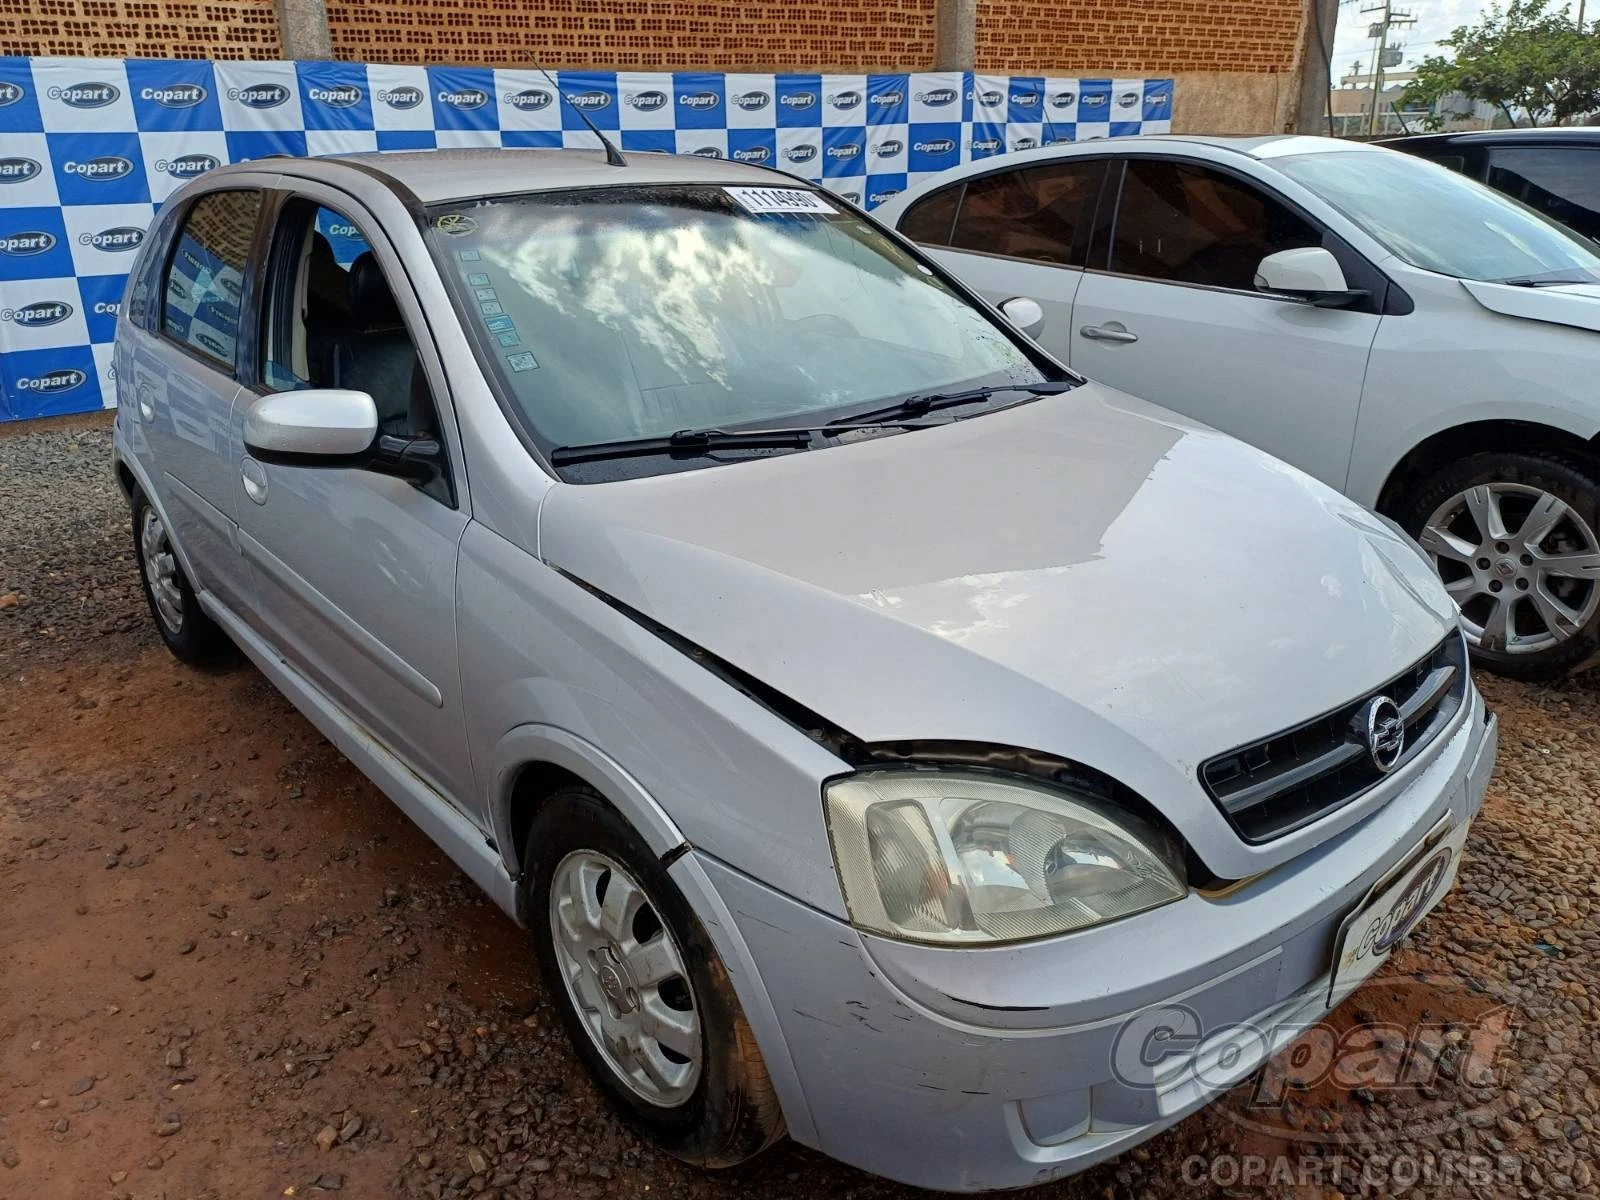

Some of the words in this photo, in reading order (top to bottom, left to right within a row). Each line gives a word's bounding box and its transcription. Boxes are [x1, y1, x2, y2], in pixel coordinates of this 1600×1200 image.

[47, 86, 110, 101] Copart
[141, 87, 200, 101] Copart
[227, 88, 281, 101] Copart
[309, 88, 357, 101] Copart
[377, 90, 417, 102] Copart
[438, 91, 482, 104] Copart
[504, 93, 546, 105] Copart
[567, 93, 606, 105] Copart
[871, 94, 899, 104] Copart
[914, 92, 953, 102] Copart
[1012, 94, 1037, 105] Copart
[624, 94, 662, 106] Copart
[680, 94, 714, 106] Copart
[731, 94, 765, 106] Copart
[780, 95, 812, 106] Copart
[827, 95, 857, 105] Copart
[1081, 95, 1105, 105] Copart
[827, 147, 858, 157] Copart
[872, 144, 899, 155] Copart
[913, 142, 951, 152] Copart
[734, 150, 766, 161] Copart
[781, 148, 813, 159] Copart
[64, 160, 126, 174] Copart
[155, 159, 213, 173] Copart
[329, 224, 363, 237] Cop
[0, 235, 47, 251] opart
[79, 231, 140, 246] Copart
[1, 304, 63, 321] Copart
[17, 373, 79, 390] Copart
